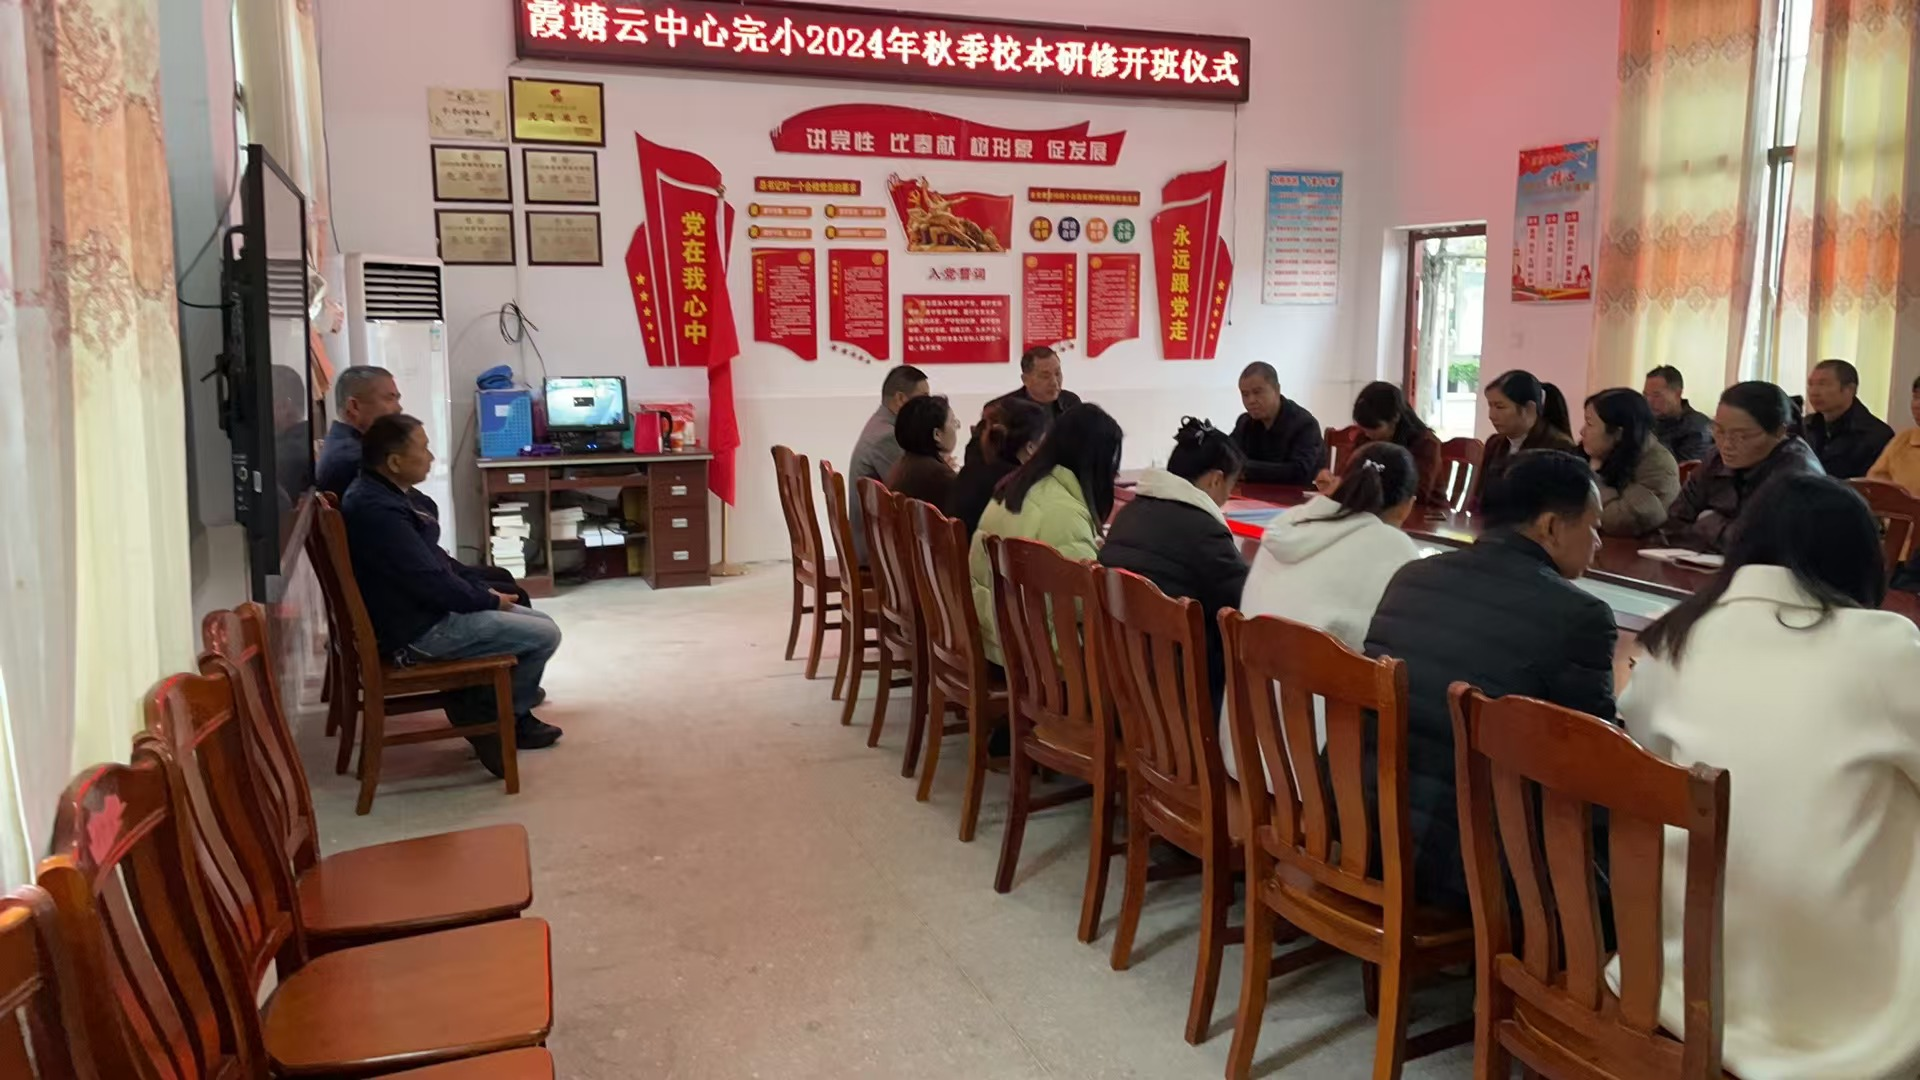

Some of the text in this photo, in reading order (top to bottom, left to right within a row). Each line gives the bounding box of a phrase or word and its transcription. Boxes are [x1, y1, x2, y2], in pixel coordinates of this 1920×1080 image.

[527, 0, 1240, 86] 霞塘云中心完小2024年秋季校本研修开班仪式
[806, 128, 1108, 162] 讲党性 比奉献 树形象 促发展
[681, 210, 708, 345] 党在我心中
[928, 267, 986, 281] 入党誓词
[1169, 224, 1191, 342] 永远跟党走
